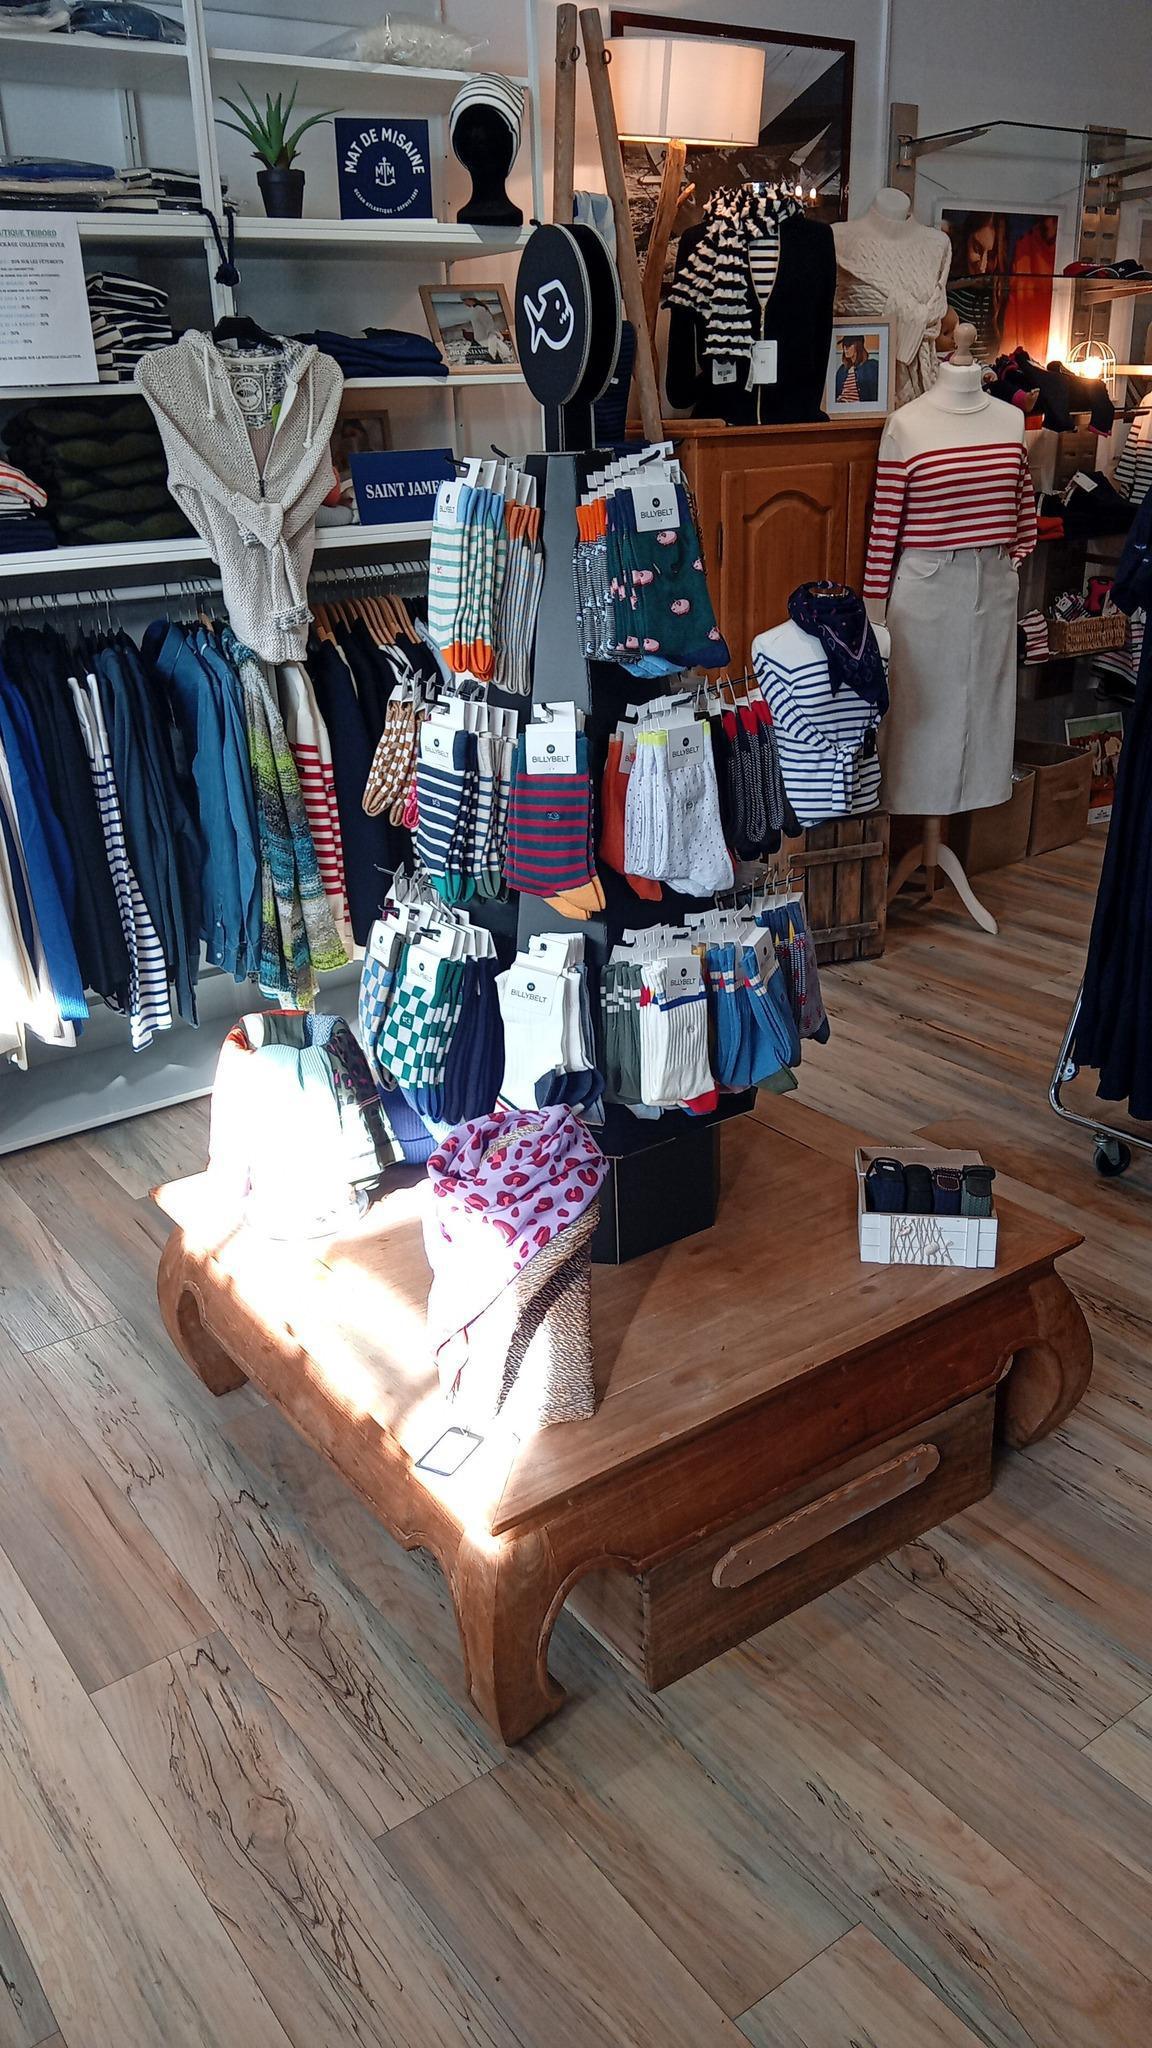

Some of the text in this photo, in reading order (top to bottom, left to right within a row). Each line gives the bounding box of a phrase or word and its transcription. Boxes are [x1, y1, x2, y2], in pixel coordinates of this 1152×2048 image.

[344, 127, 425, 175] MAT DE MISAINE
[365, 480, 444, 499] SAINT JAME
[640, 508, 673, 519] BILLYBELT
[672, 746, 700, 758] BILLYBELT
[531, 755, 570, 763] BILLYBELT
[670, 978, 697, 986] BILLYBELT
[510, 988, 548, 1003] BILLYBELT
